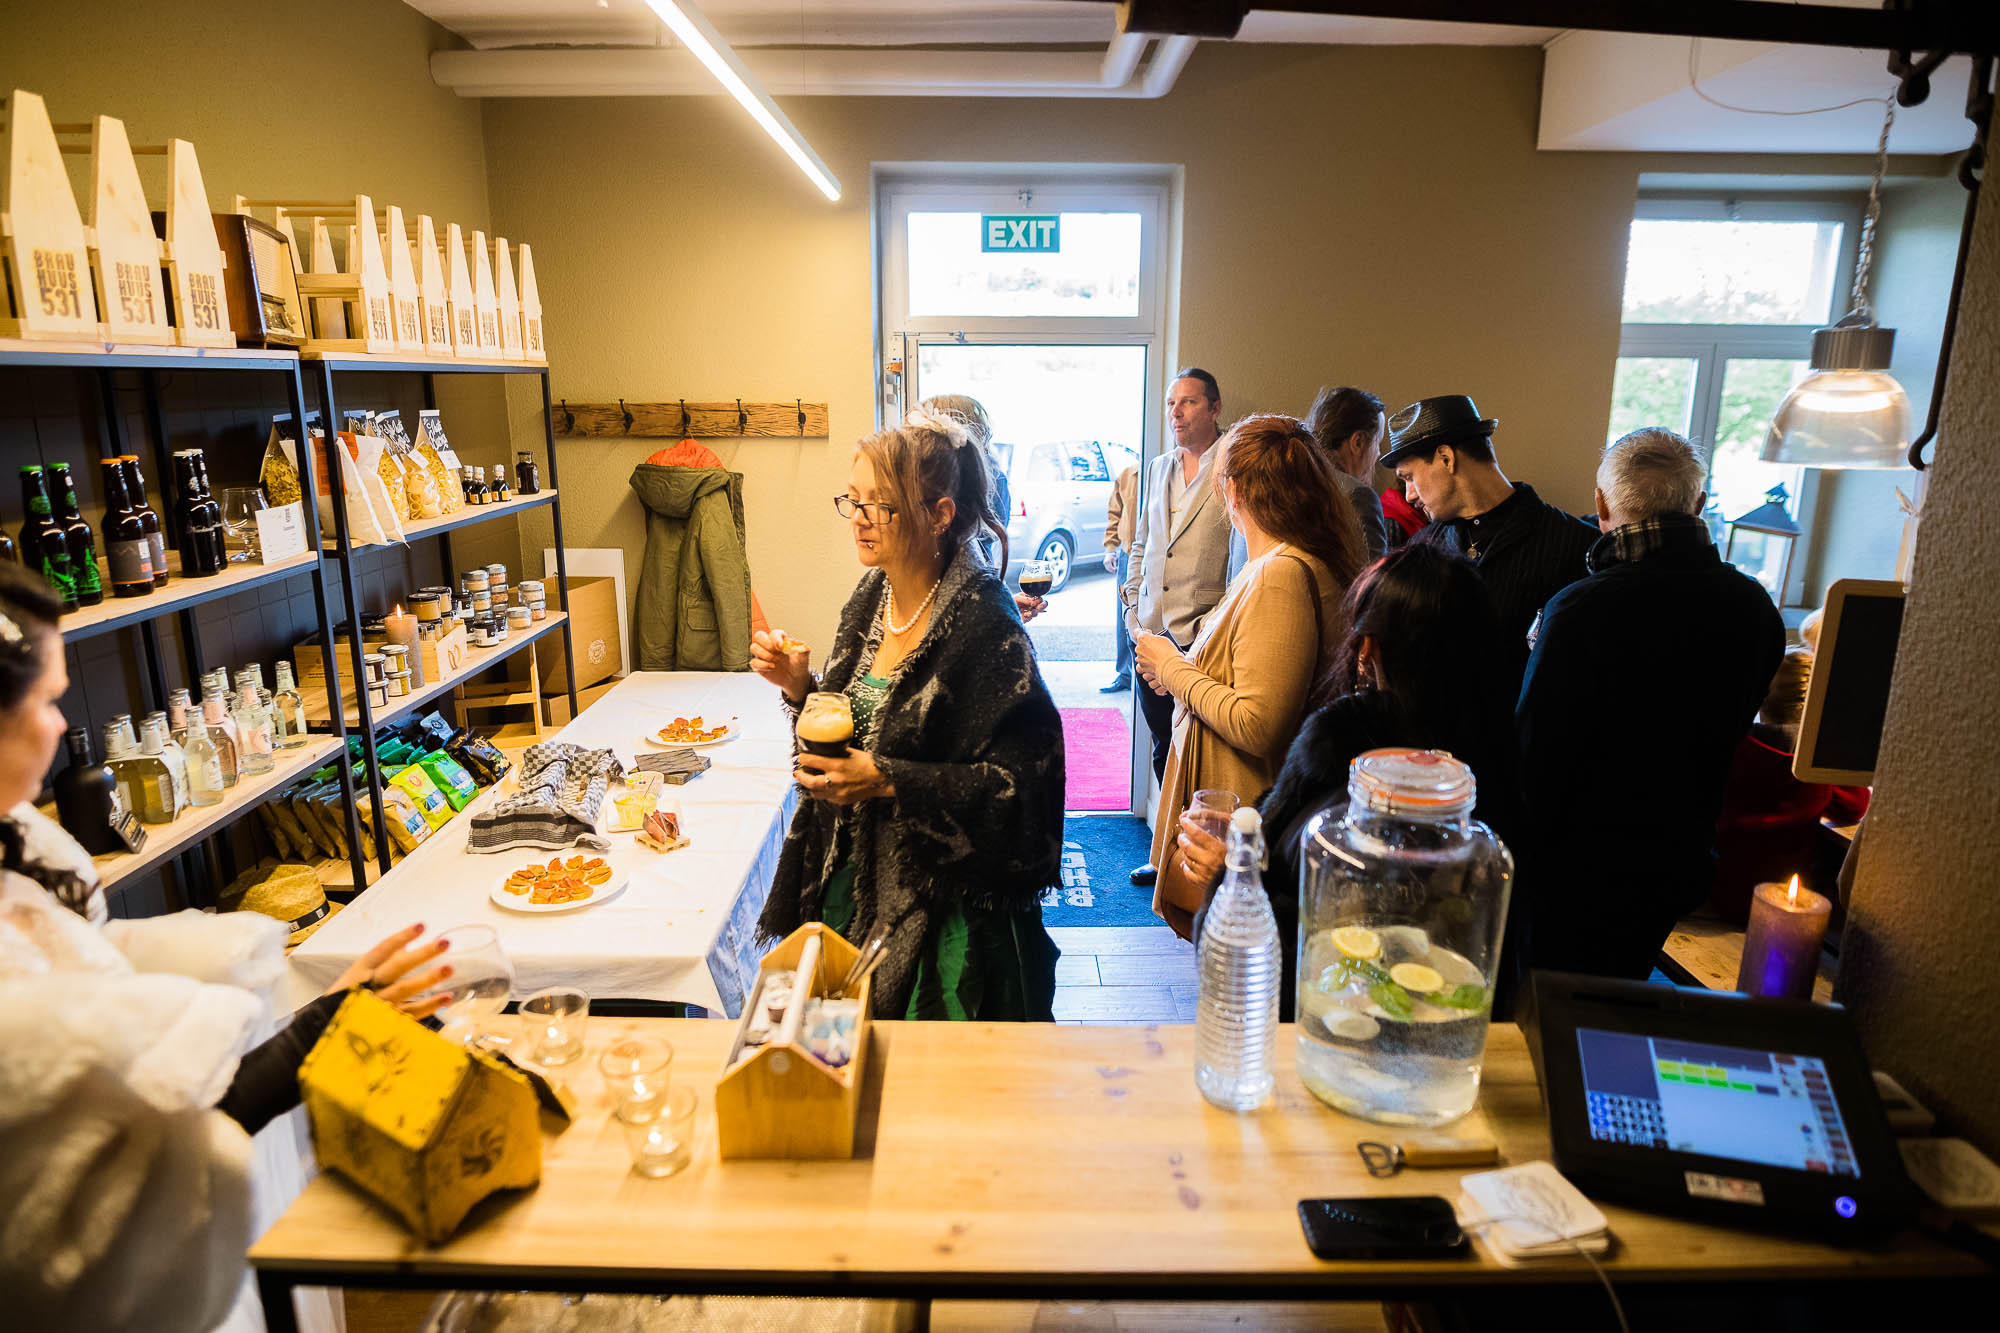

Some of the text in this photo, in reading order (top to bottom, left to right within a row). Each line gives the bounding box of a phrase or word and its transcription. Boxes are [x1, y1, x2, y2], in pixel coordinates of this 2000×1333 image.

[988, 220, 1056, 248] EXIT
[115, 262, 150, 281] BRAU
[40, 288, 81, 319] 531
[121, 297, 155, 325] 531
[192, 304, 220, 330] 531
[373, 321, 388, 340] 531
[432, 327, 446, 344] 531
[460, 329, 473, 345] 531
